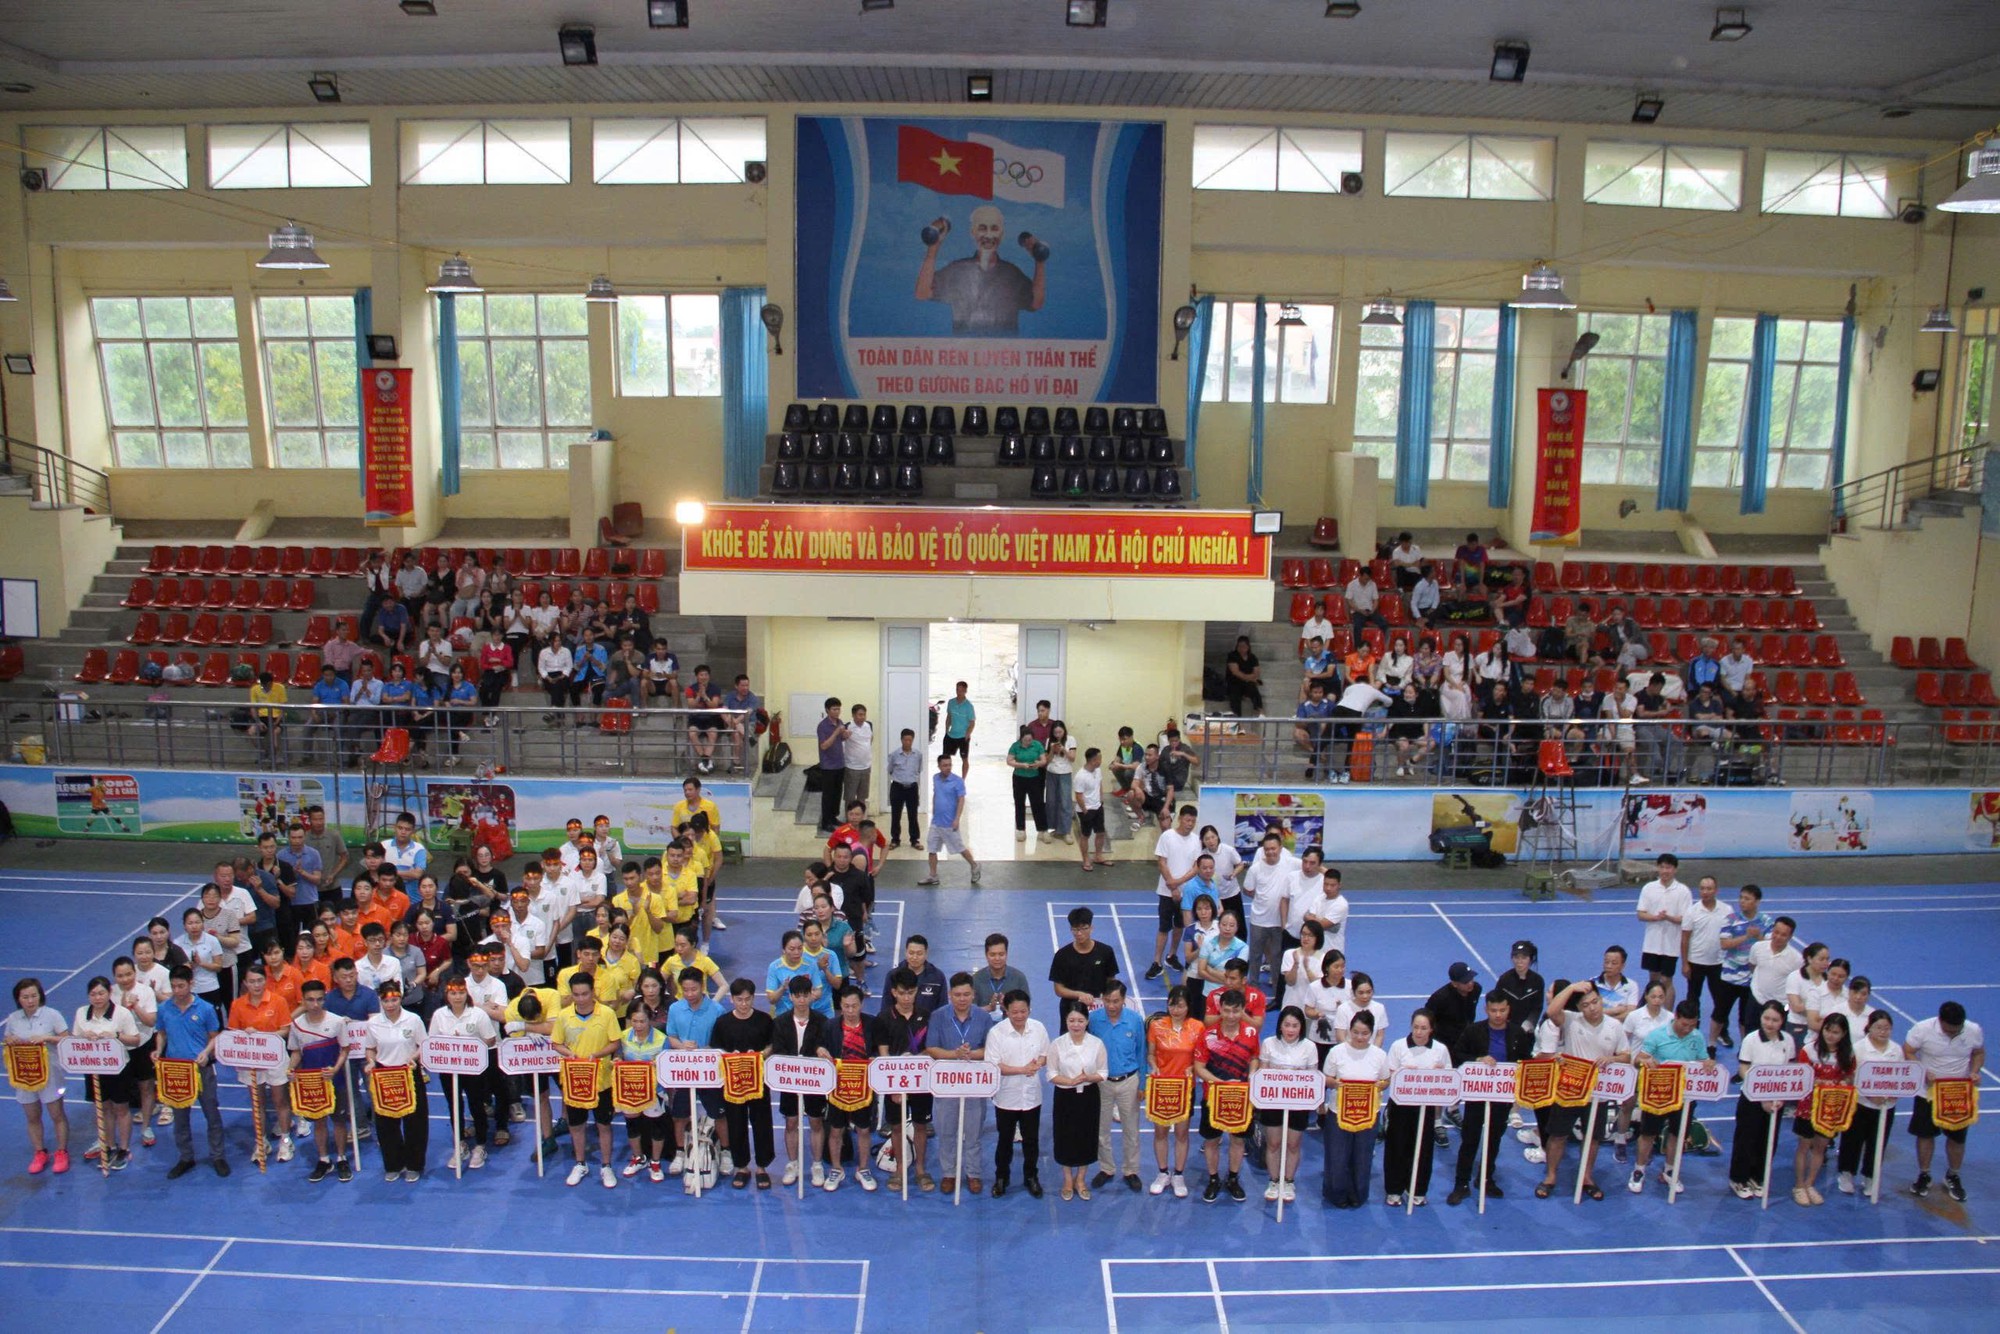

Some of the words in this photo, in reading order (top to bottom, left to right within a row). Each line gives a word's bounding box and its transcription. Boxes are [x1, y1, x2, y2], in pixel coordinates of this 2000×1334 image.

[857, 346, 897, 366] TOÀN
[903, 346, 933, 366] DÂN
[939, 347, 968, 366] RÈN
[974, 348, 1020, 370] LUYỆN
[1026, 347, 1065, 368] THÂN
[1070, 344, 1097, 368] THỂ
[876, 376, 914, 393] THEO
[919, 375, 970, 394] GƯƠNG
[975, 374, 1004, 394] BÁC
[1010, 372, 1029, 394] HỒ
[1035, 375, 1048, 394] VĨ
[1053, 378, 1078, 398] ĐẠI
[702, 520, 742, 557] KHỎE
[748, 519, 769, 558] ĐỂ
[773, 525, 803, 559] XÂY
[809, 528, 852, 565] DỰNG
[857, 525, 877, 560] VÀ
[882, 522, 914, 560] BẢO
[919, 527, 938, 566] VỆ
[943, 521, 964, 561] TỔ
[967, 523, 1009, 562] QUỐC
[1015, 528, 1048, 568] VIỆT
[1053, 535, 1089, 562] NAM
[1095, 529, 1116, 563] XÃ
[1121, 529, 1148, 569] HỘI
[1153, 526, 1184, 564] CHỦ
[1189, 531, 1238, 565] NGHĨA
[1243, 536, 1248, 564] !
[233, 1034, 248, 1045] CÔNG
[248, 1037, 256, 1046] TY
[256, 1037, 267, 1046] MAY
[429, 1040, 450, 1052] CÔNG
[452, 1043, 461, 1052] TY
[463, 1043, 479, 1053] MAY
[71, 1042, 94, 1054] TRẠM
[95, 1043, 101, 1052] Y
[102, 1040, 111, 1052] TẾ
[514, 1043, 536, 1054] TRẠM
[67, 1055, 78, 1066] XÃ
[80, 1054, 101, 1066] HỒNG
[103, 1057, 119, 1067] SƠN
[223, 1047, 236, 1058] XUẤT
[262, 1050, 278, 1062] NGHĨA
[430, 1053, 449, 1065] THÊU
[451, 1055, 462, 1066] MỸ
[464, 1056, 480, 1067] ĐỨC
[508, 1056, 519, 1067] XÃ
[522, 1055, 545, 1066] PHÚC
[669, 1053, 686, 1063] CÂU
[688, 1055, 704, 1065] LẠC
[706, 1053, 716, 1065] BỘ
[775, 1062, 800, 1074] BỆNH
[803, 1063, 826, 1076] VIỆN
[878, 1061, 896, 1071] CÂU
[899, 1063, 915, 1072] LẠC
[918, 1062, 930, 1073] BỘ
[1465, 1065, 1483, 1076] CÂU
[1485, 1067, 1502, 1079] LẠC
[1504, 1067, 1515, 1079] BỘ
[1614, 1067, 1626, 1078] BỘ
[1688, 1067, 1705, 1078] LẠC
[1756, 1067, 1773, 1077] CÂU
[1775, 1069, 1791, 1078] LẠC
[1792, 1067, 1804, 1077] BỘ
[1870, 1066, 1893, 1077] TRẠM
[1894, 1067, 1900, 1076] Y
[1901, 1064, 1911, 1076] TẾ
[671, 1068, 699, 1082] THÔN
[703, 1070, 717, 1082] 10
[887, 1076, 894, 1088] T
[899, 1075, 909, 1088] &
[914, 1075, 922, 1088] T
[935, 1072, 972, 1087] TRỌNG
[975, 1070, 993, 1084] TÀI
[1263, 1073, 1294, 1082] TRƯỜNG
[1296, 1074, 1314, 1082] THCS
[1423, 1075, 1433, 1083] KHU
[1441, 1074, 1452, 1084] TÍCH
[779, 1076, 792, 1085] ĐA
[795, 1078, 821, 1088] KHOA
[1462, 1080, 1493, 1093] THANH
[1496, 1081, 1516, 1094] SƠN
[1606, 1082, 1625, 1094] SƠN
[1698, 1080, 1718, 1092] SƠN
[1900, 1080, 1917, 1091] SƠN
[1260, 1086, 1278, 1101] ĐẠI
[1282, 1085, 1315, 1100] NGHĨA
